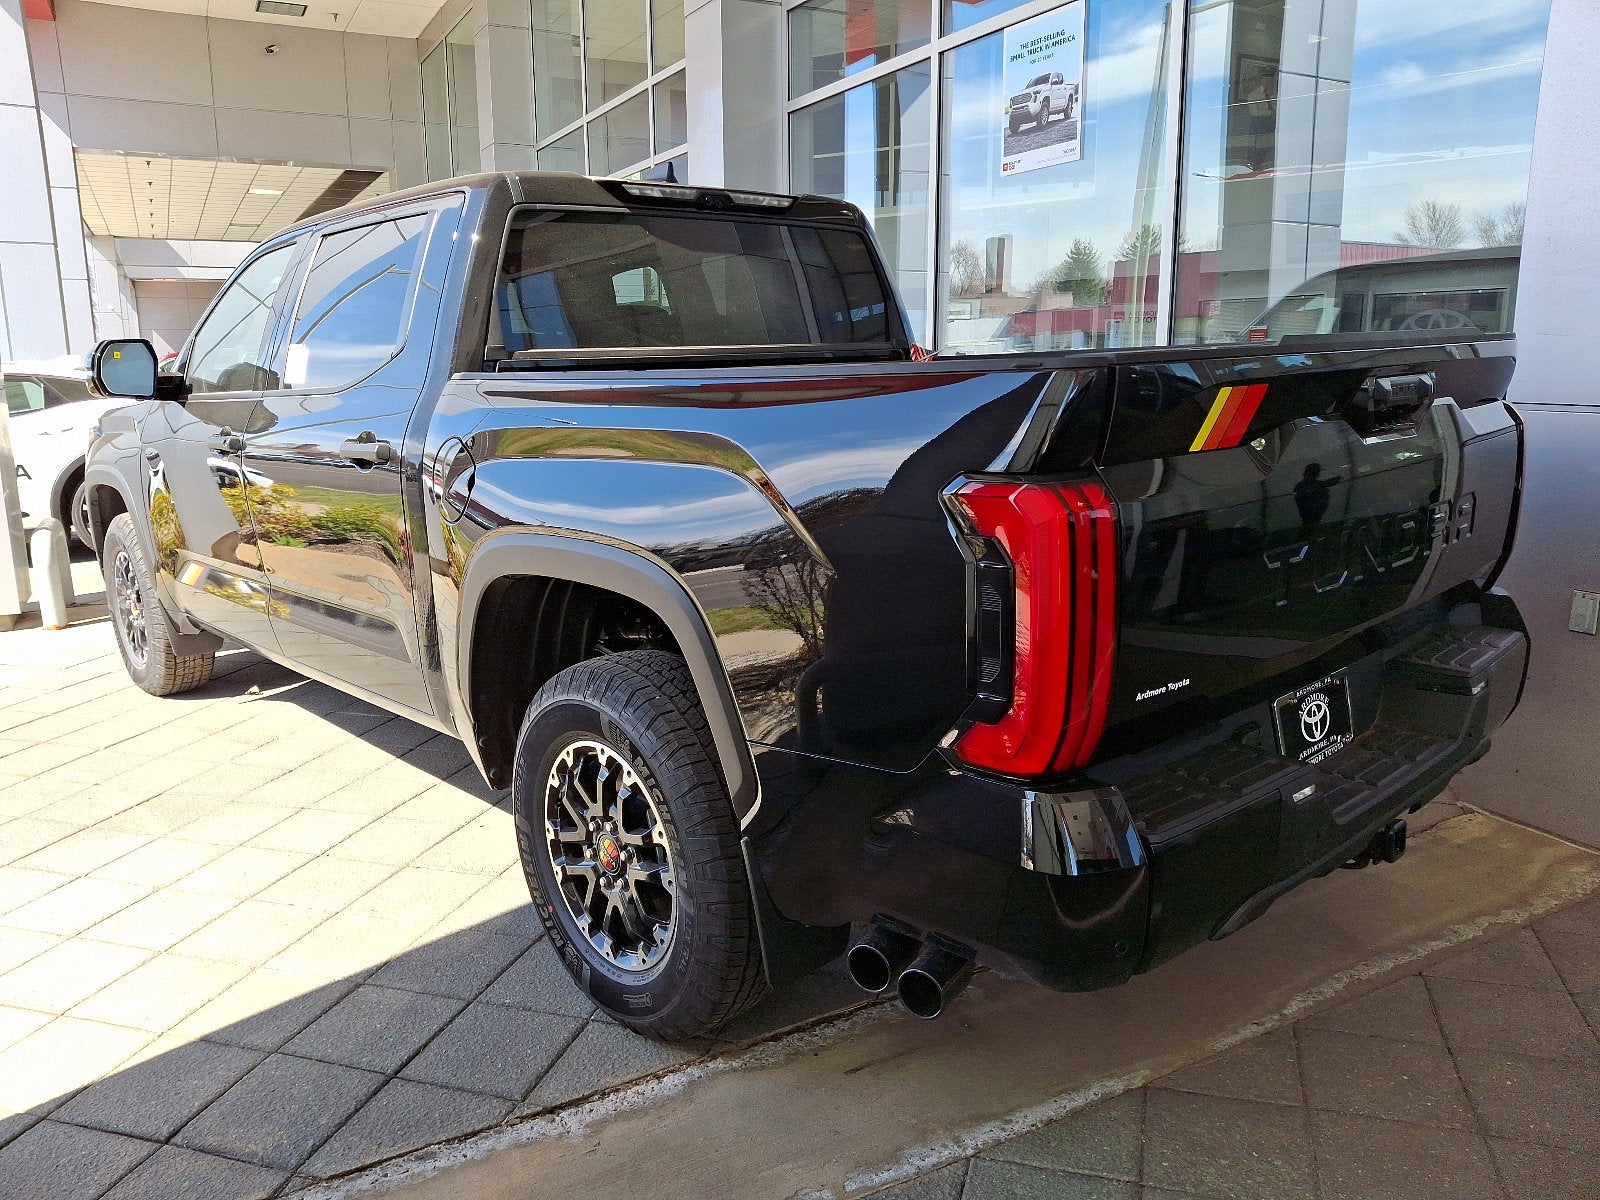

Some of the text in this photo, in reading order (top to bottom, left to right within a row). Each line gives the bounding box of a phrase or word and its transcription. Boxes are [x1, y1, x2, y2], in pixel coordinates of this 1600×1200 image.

[1010, 34, 1076, 62] SMALL TRUCK IN AMERICA
[1020, 29, 1065, 50] THE BEST-SELLING
[1263, 490, 1477, 607] TUNDRA
[1135, 678, 1190, 701] Ardmore Toyota
[1296, 682, 1324, 697] ARDMORE,
[1298, 692, 1330, 718] ARDMORE
[1308, 741, 1344, 764] MORE TOYOTA
[633, 755, 689, 890] MICHELIN
[518, 833, 567, 948] MICHELIN
